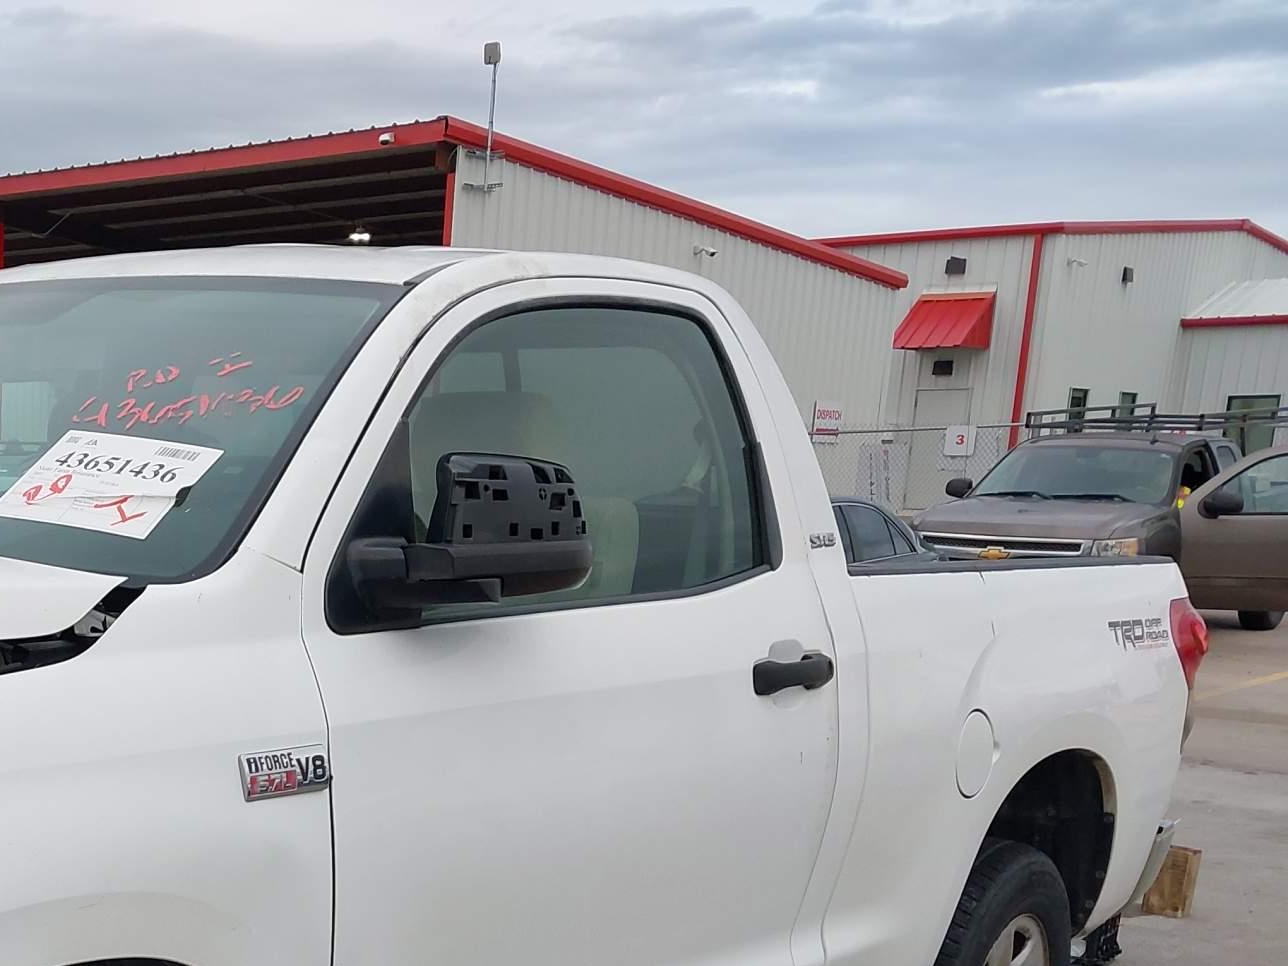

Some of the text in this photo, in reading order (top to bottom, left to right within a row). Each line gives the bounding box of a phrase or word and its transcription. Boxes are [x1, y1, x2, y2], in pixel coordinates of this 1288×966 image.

[955, 434, 965, 446] 3
[55, 451, 185, 484] 43651436
[1108, 619, 1145, 651] TRD
[1146, 629, 1169, 641] ROAD
[295, 754, 328, 783] V8
